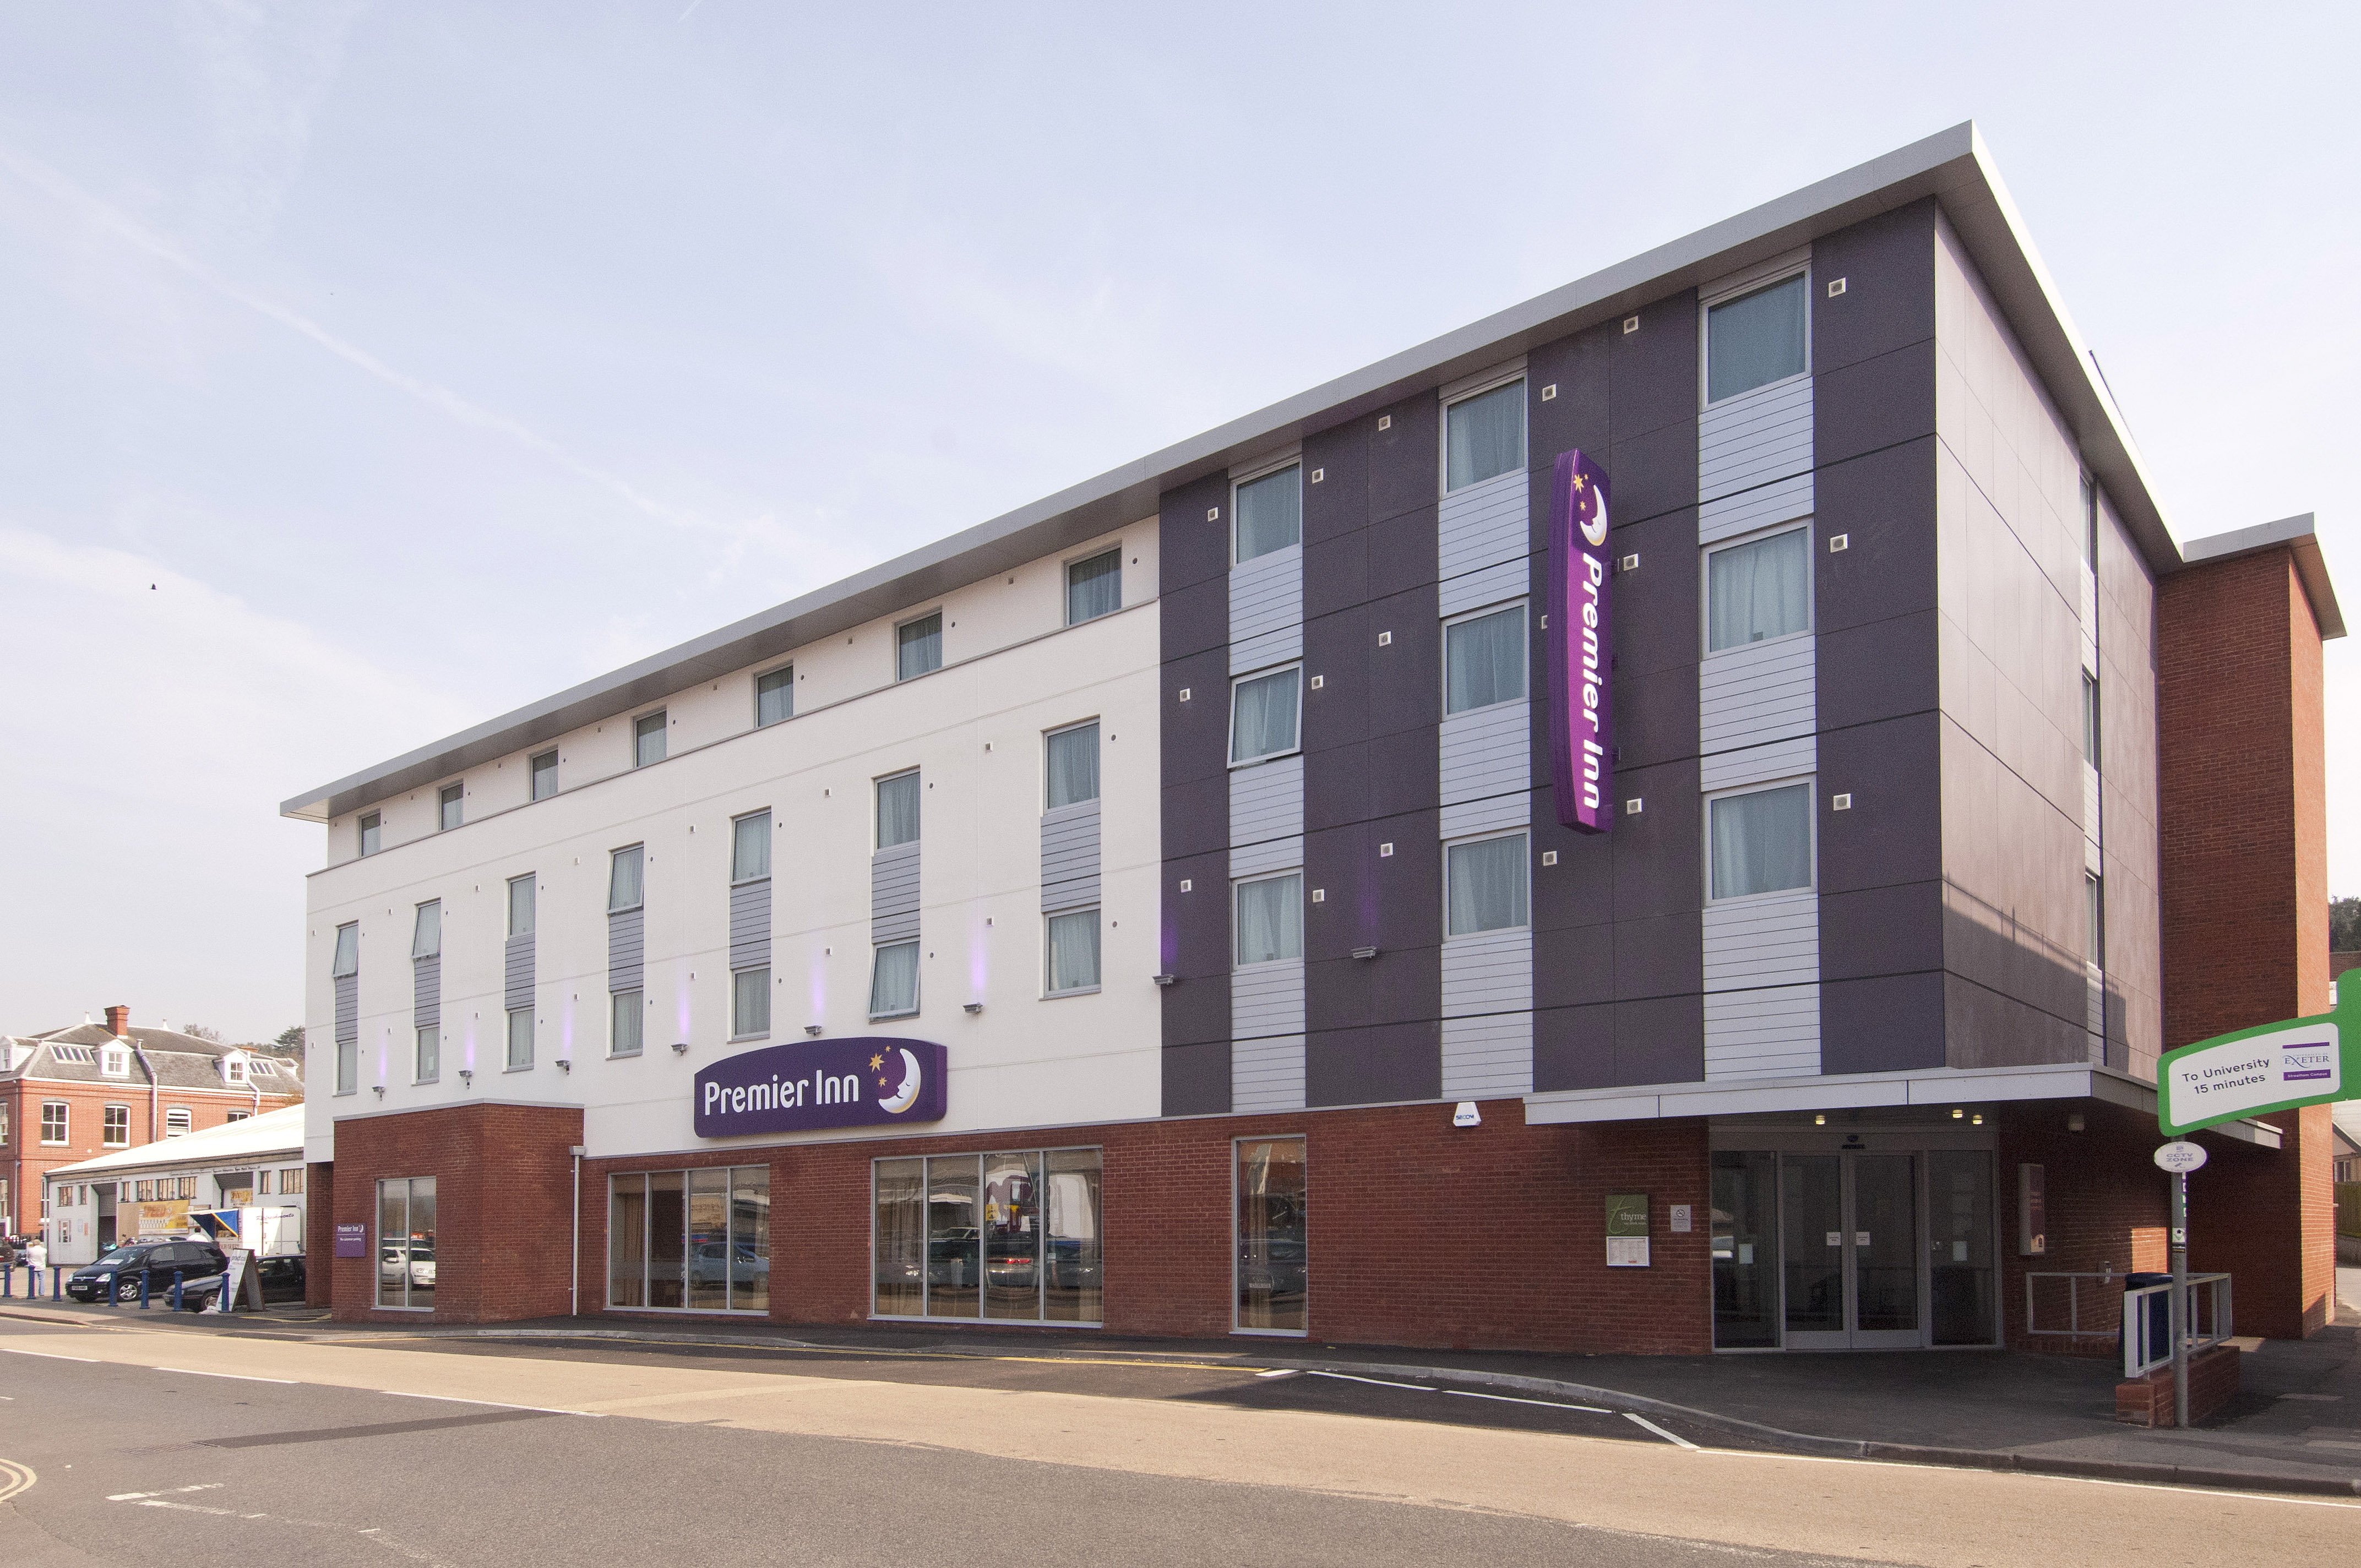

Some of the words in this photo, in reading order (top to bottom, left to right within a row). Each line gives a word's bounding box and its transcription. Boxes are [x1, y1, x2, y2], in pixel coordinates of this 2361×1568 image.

[1583, 552, 1602, 733] Premier
[1584, 739, 1603, 809] Inn
[2182, 1073, 2198, 1082] To
[2203, 1059, 2269, 1078] University
[2283, 1055, 2330, 1067] EXETER
[705, 1074, 809, 1116] Premier
[816, 1069, 859, 1105] Inn
[2194, 1084, 2208, 1094] 15
[2213, 1074, 2266, 1091] minutes
[1620, 1212, 1646, 1222] thyme
